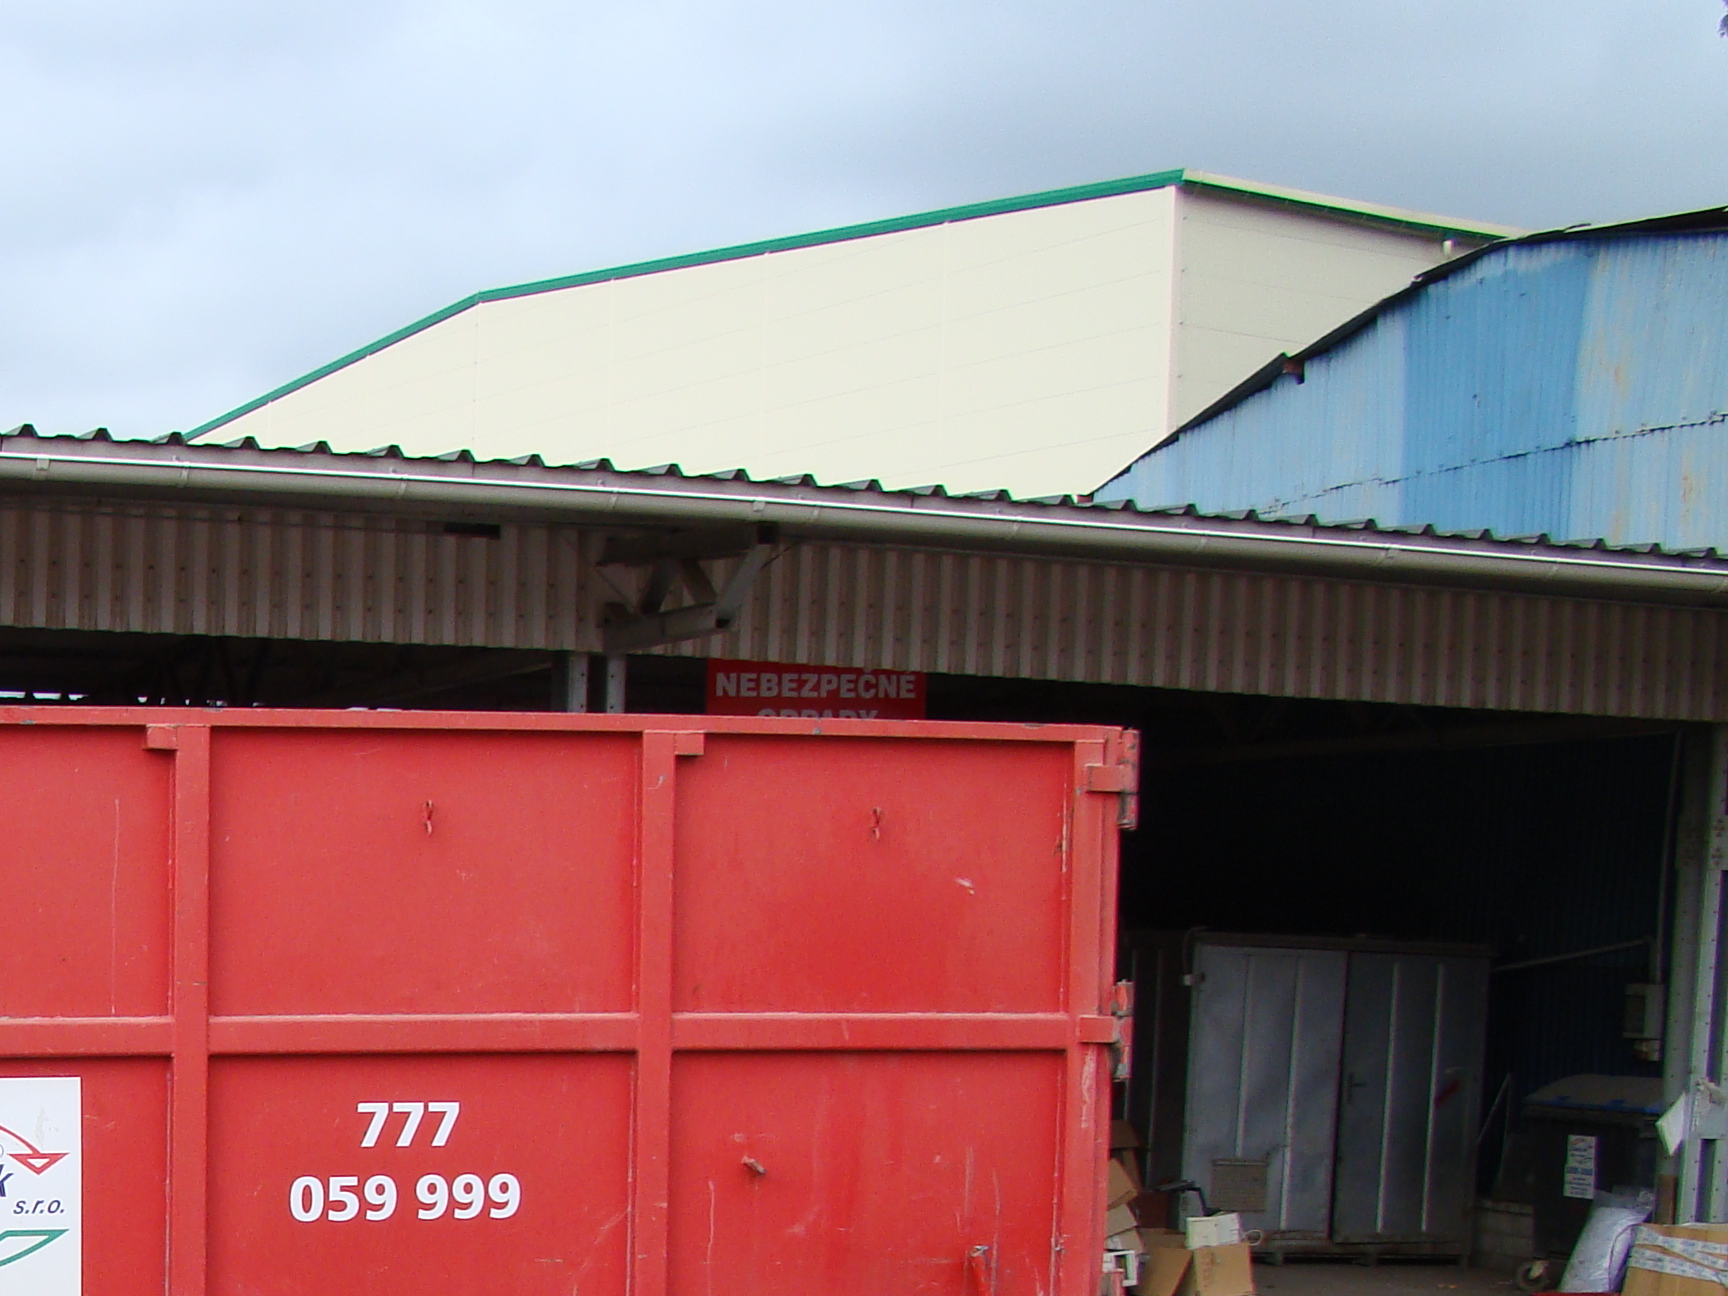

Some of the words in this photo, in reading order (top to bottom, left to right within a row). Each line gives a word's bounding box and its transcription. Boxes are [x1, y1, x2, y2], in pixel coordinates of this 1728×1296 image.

[715, 668, 916, 699] NEBEZPEČNÉ
[356, 1101, 460, 1148] 777
[12, 1197, 66, 1215] s.r.o.
[289, 1175, 398, 1222] 059
[415, 1173, 521, 1220] 999
